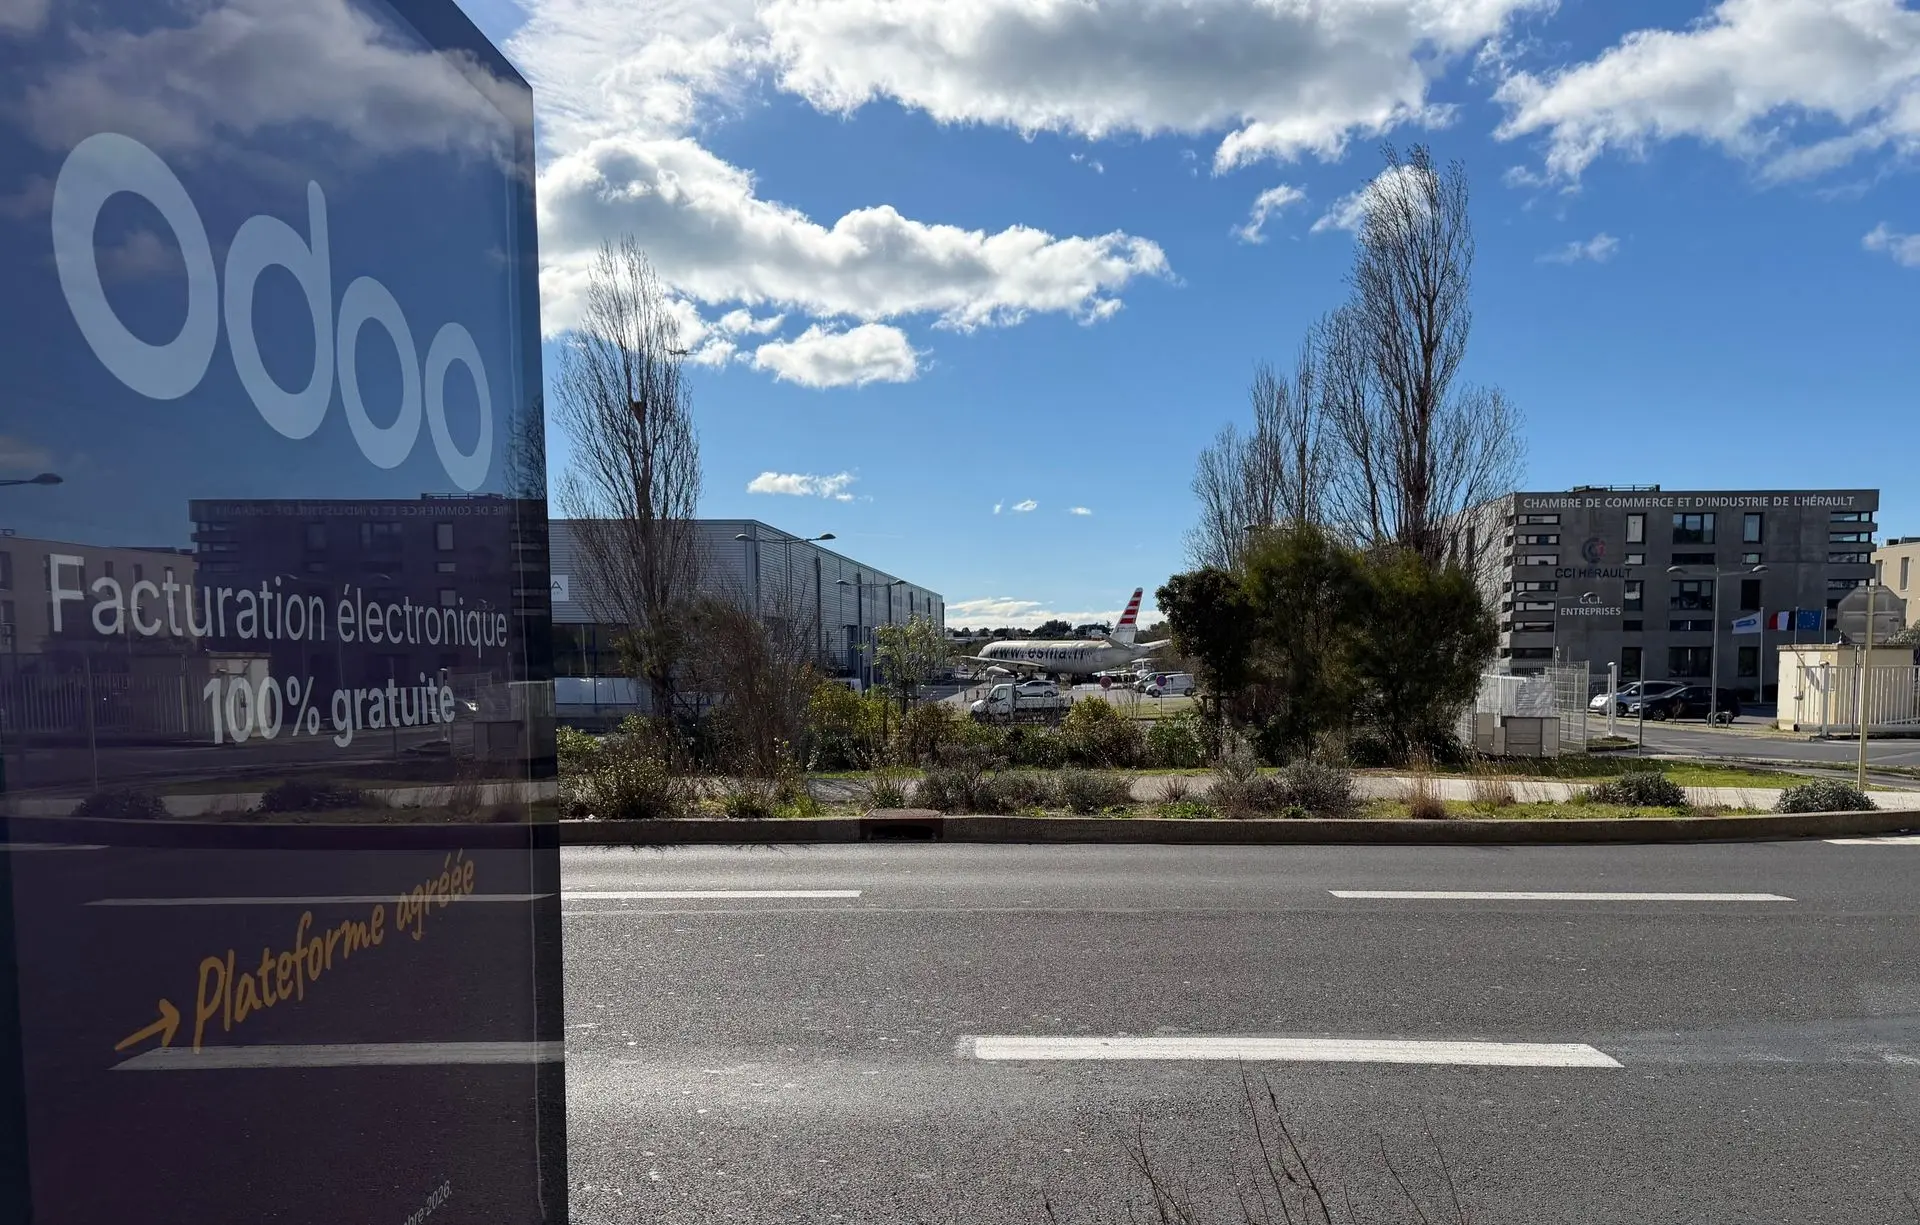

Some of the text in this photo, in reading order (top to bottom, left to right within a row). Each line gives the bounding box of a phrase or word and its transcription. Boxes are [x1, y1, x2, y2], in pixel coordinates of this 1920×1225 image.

[52, 132, 493, 491] Odoo
[1523, 494, 1855, 508] CHAMBRE DE COMMERCE ET D'INDUSTRIE DE L'HÉRAULT
[1555, 568, 1575, 578] CCI
[49, 553, 508, 658] Facturation électronique
[1561, 607, 1621, 616] ENTREPRISES
[204, 671, 455, 747] 100% gratuite
[193, 848, 474, 1054] Plateforme agréée
[427, 1180, 452, 1216] 2026.
